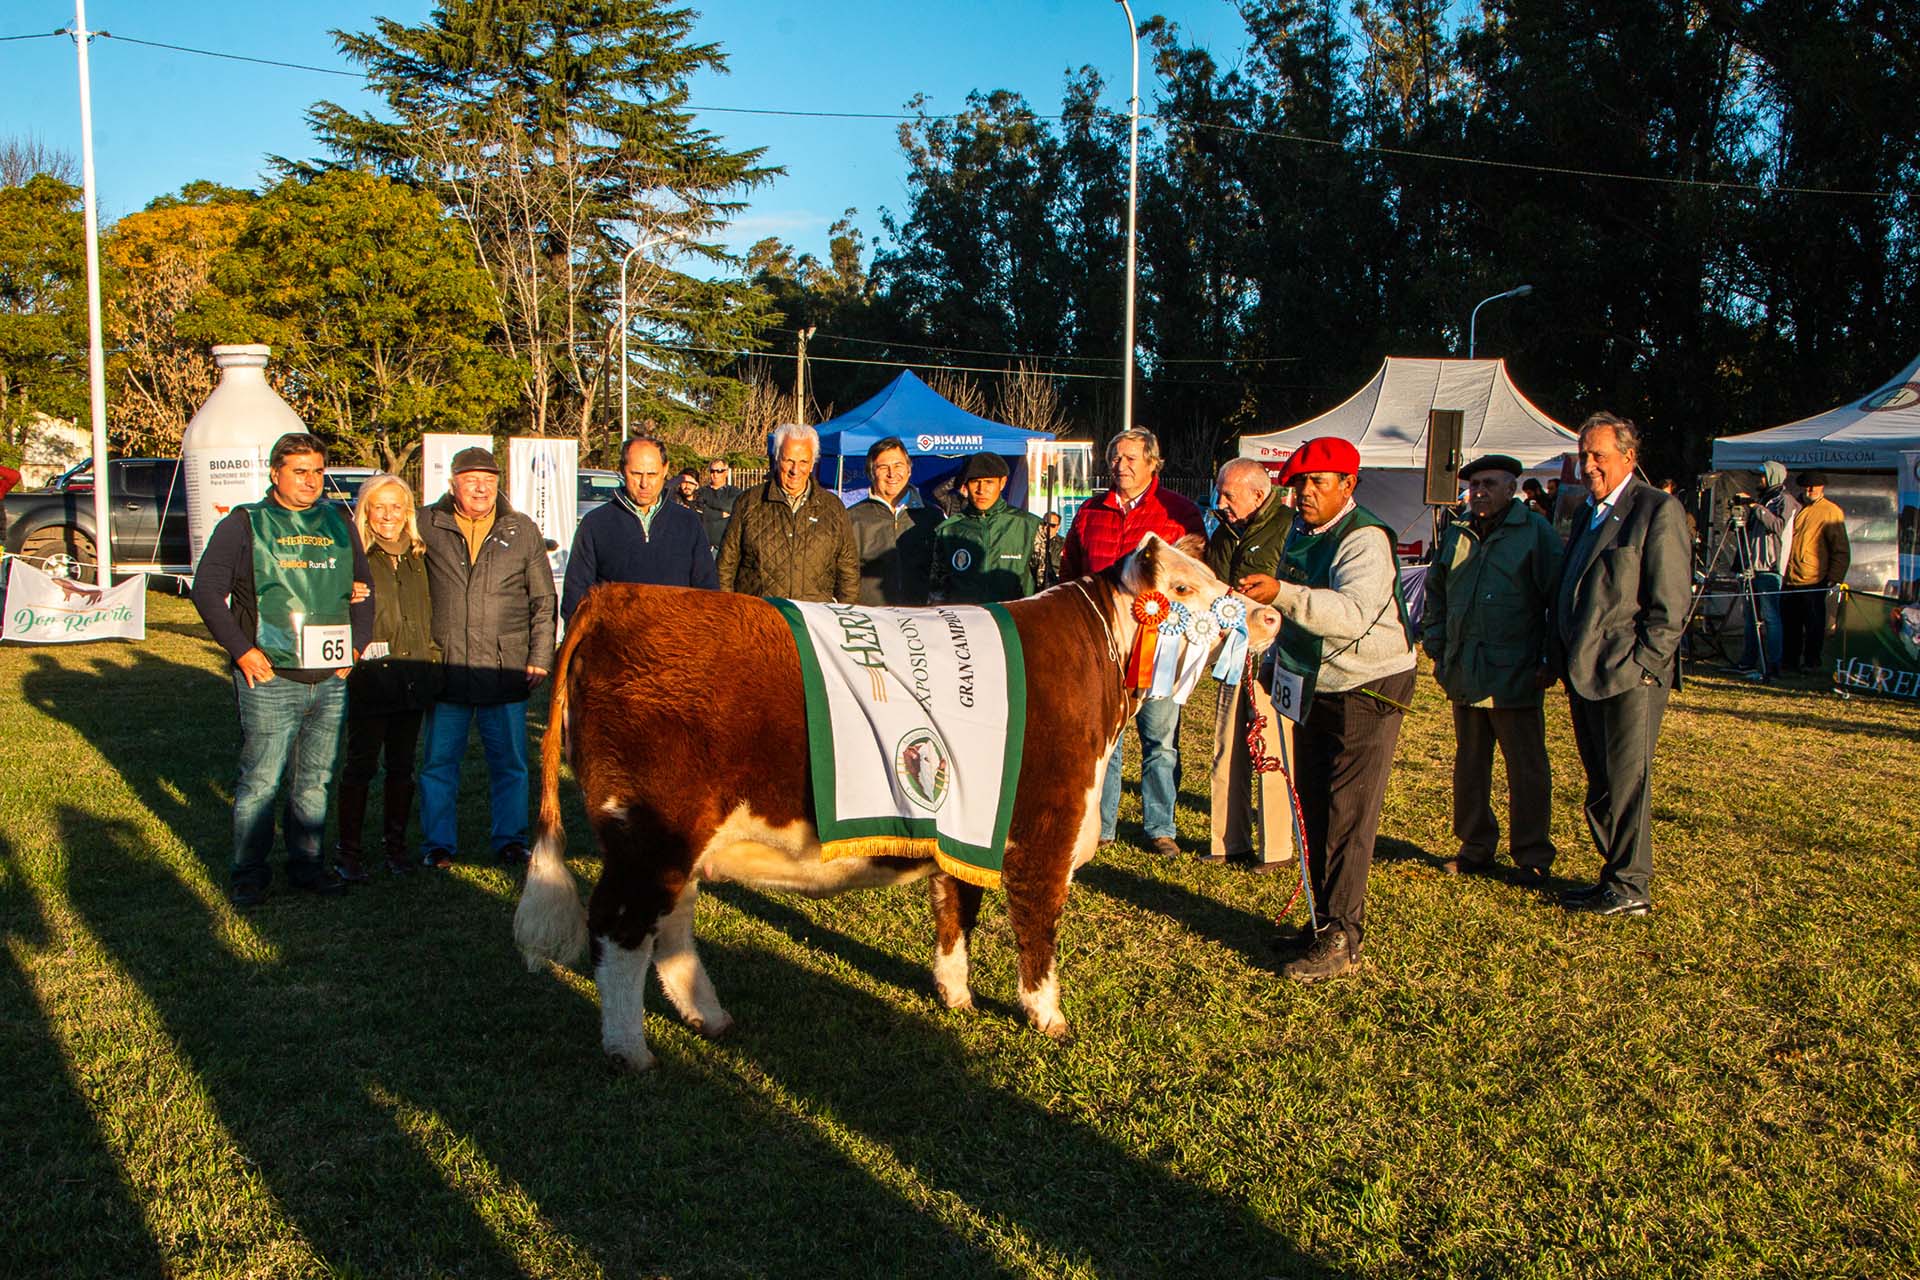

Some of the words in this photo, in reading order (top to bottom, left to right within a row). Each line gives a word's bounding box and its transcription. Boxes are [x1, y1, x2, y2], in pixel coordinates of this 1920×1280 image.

[933, 435, 983, 445] BISCAYART
[281, 535, 331, 547] HEREFORD
[308, 559, 328, 569] Rural
[13, 608, 56, 634] Don
[63, 605, 135, 632] Roberto
[322, 639, 345, 662] 65
[957, 661, 975, 708] GRAN
[1274, 680, 1292, 710] 98
